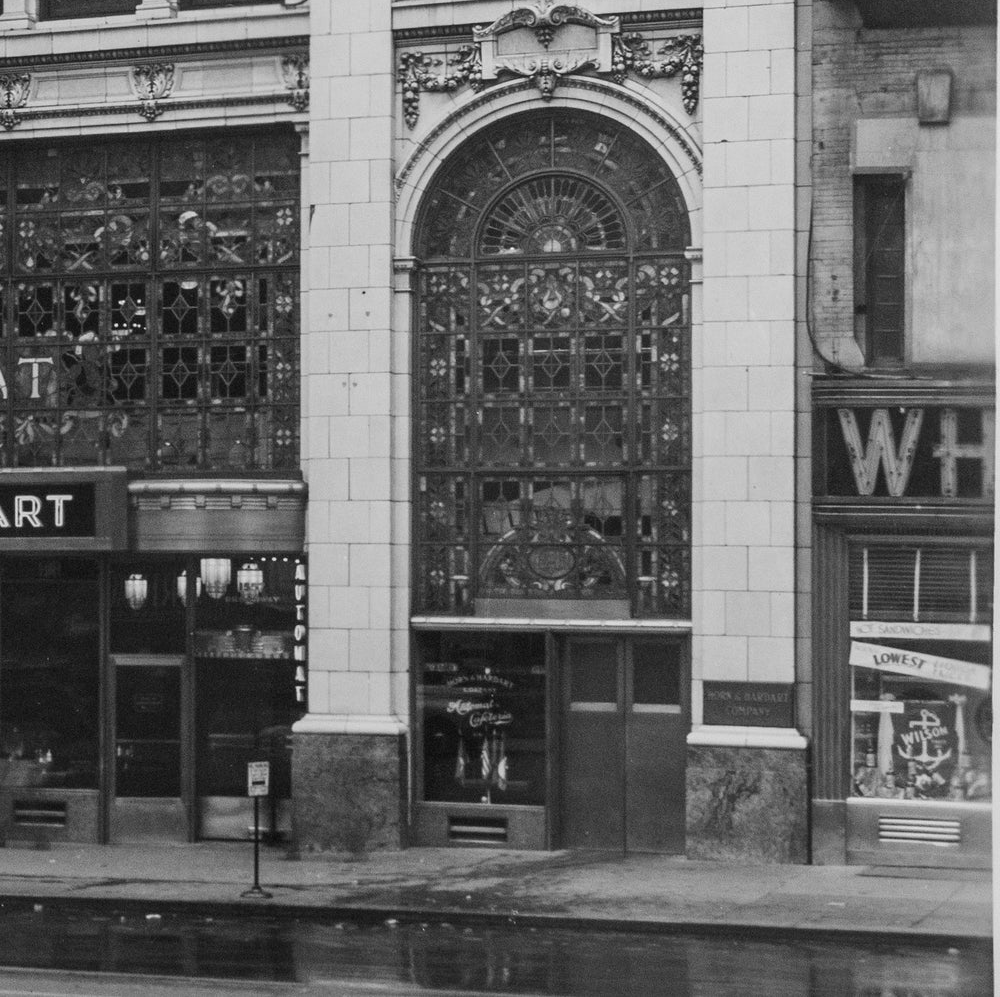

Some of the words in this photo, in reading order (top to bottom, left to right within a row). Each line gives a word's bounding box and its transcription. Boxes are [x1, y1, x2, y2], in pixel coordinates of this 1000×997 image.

[293, 563, 306, 702] AUTOMAT
[873, 652, 927, 670] LOWEST
[900, 725, 949, 746] WILSON
